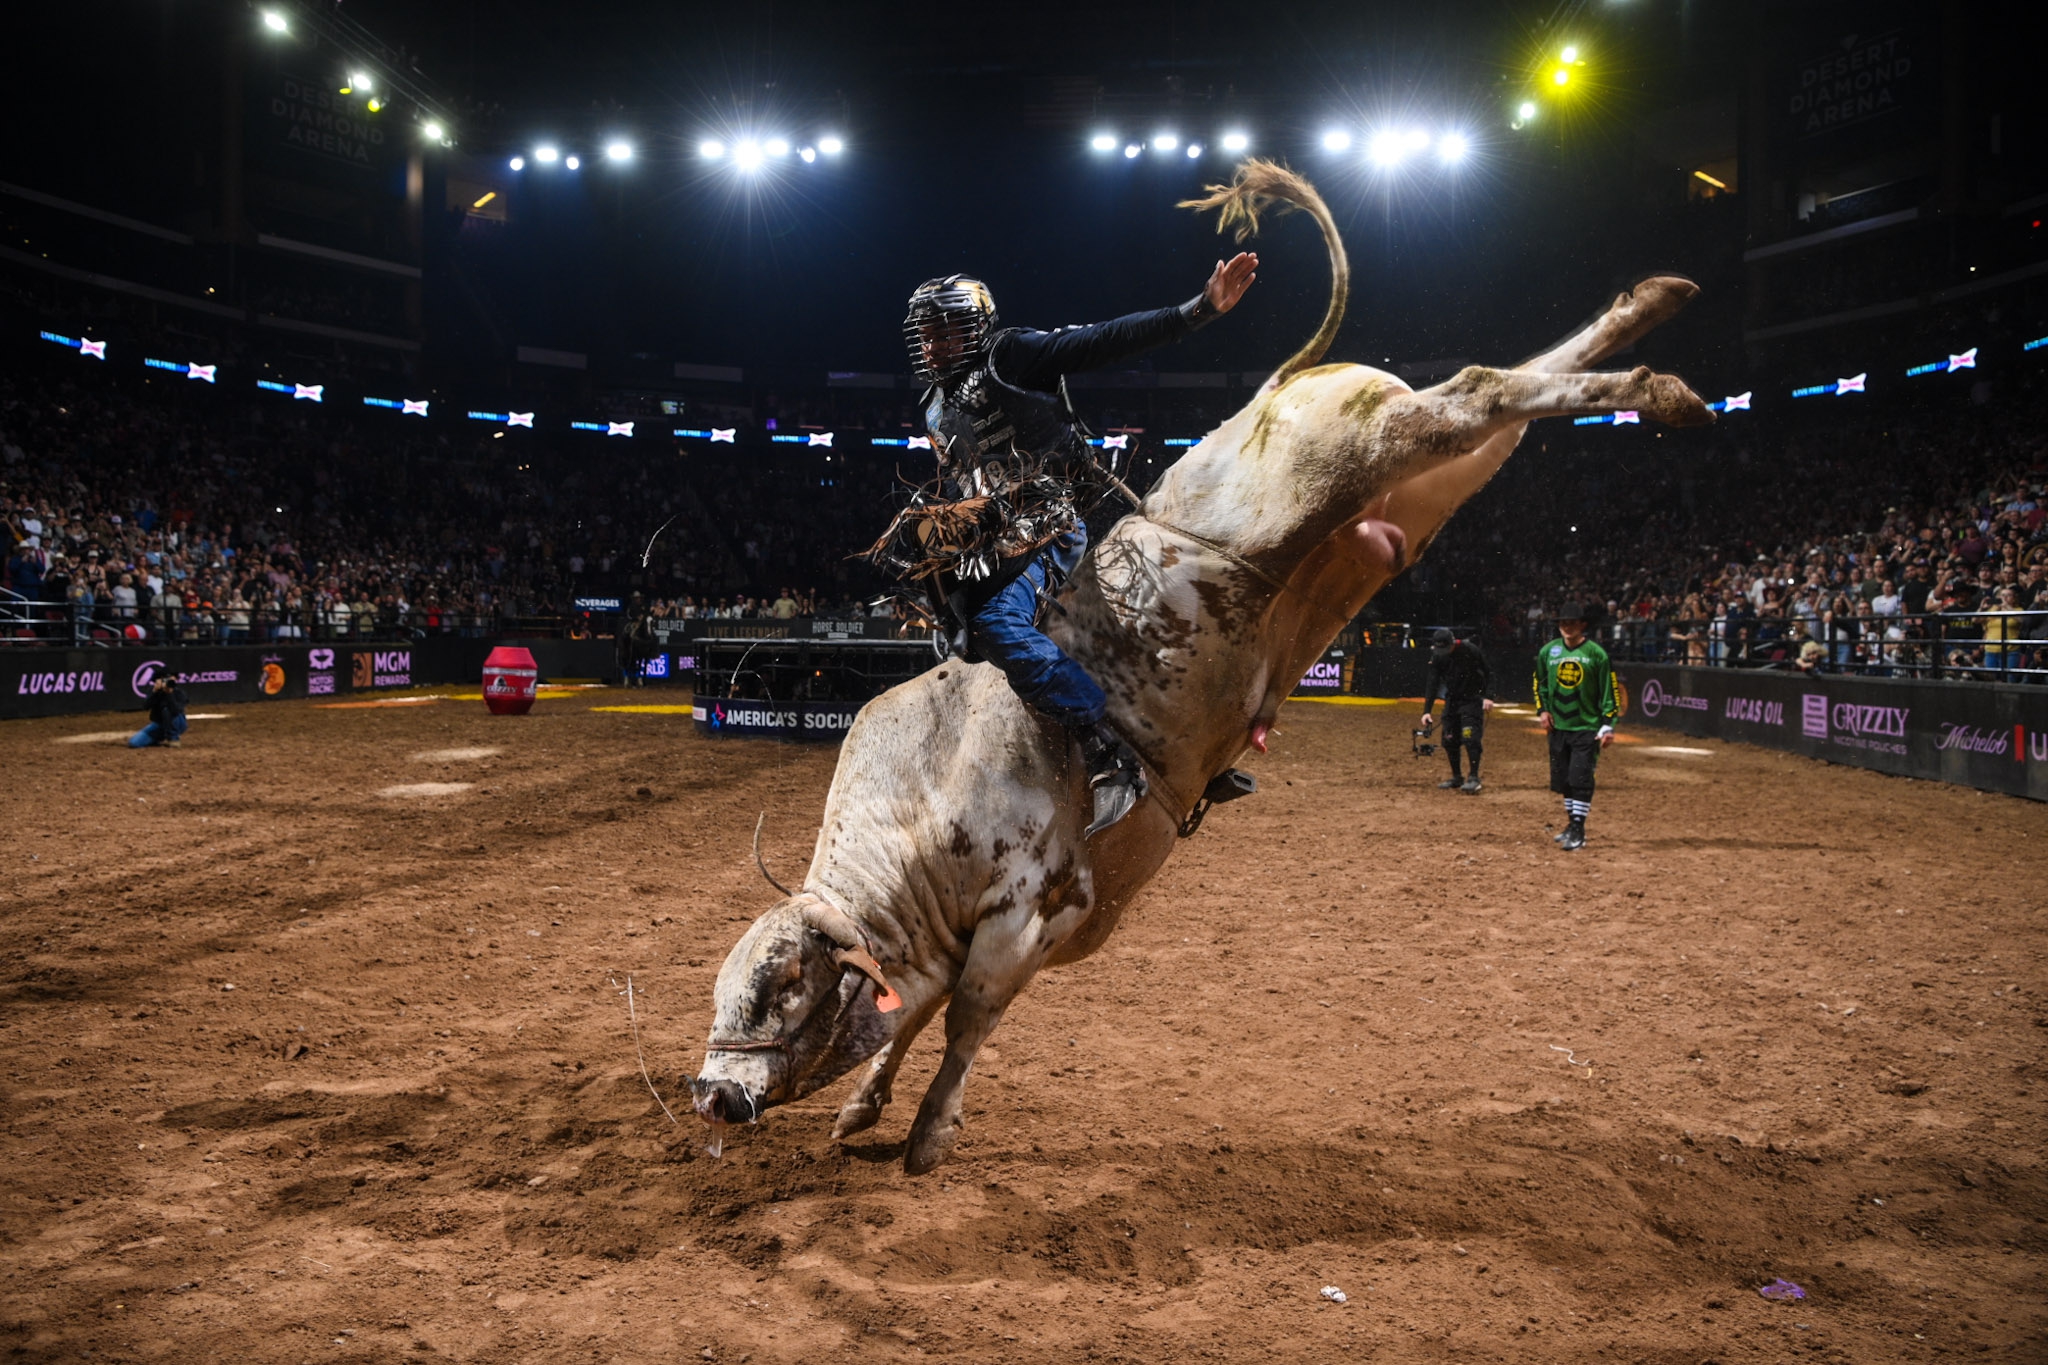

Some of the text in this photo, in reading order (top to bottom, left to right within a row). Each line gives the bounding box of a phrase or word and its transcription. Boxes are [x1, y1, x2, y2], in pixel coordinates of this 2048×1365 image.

[1801, 38, 1899, 90] DESERT
[284, 80, 373, 119] DESER
[1790, 57, 1912, 114] DIAMOND
[271, 97, 385, 145] DIAMOND
[1806, 88, 1896, 131] ARENA
[287, 125, 369, 162] ARENA
[657, 619, 685, 632] SOLDIER
[812, 621, 834, 635] HORSE
[836, 621, 864, 636] SOLDIER
[374, 651, 410, 672] MGM
[18, 671, 104, 695] LUCAS OIL
[174, 671, 237, 685] Z-ACCESS
[374, 674, 411, 686] REWARDS
[1299, 679, 1340, 687] REWARDS
[726, 709, 798, 728] AMERICA'S
[804, 712, 857, 729] SOCIA
[1725, 697, 1763, 723] LUCAS
[1764, 700, 1784, 726] OIL
[1832, 702, 1910, 737] GRIZZLY
[1934, 721, 2009, 755] Michelob
